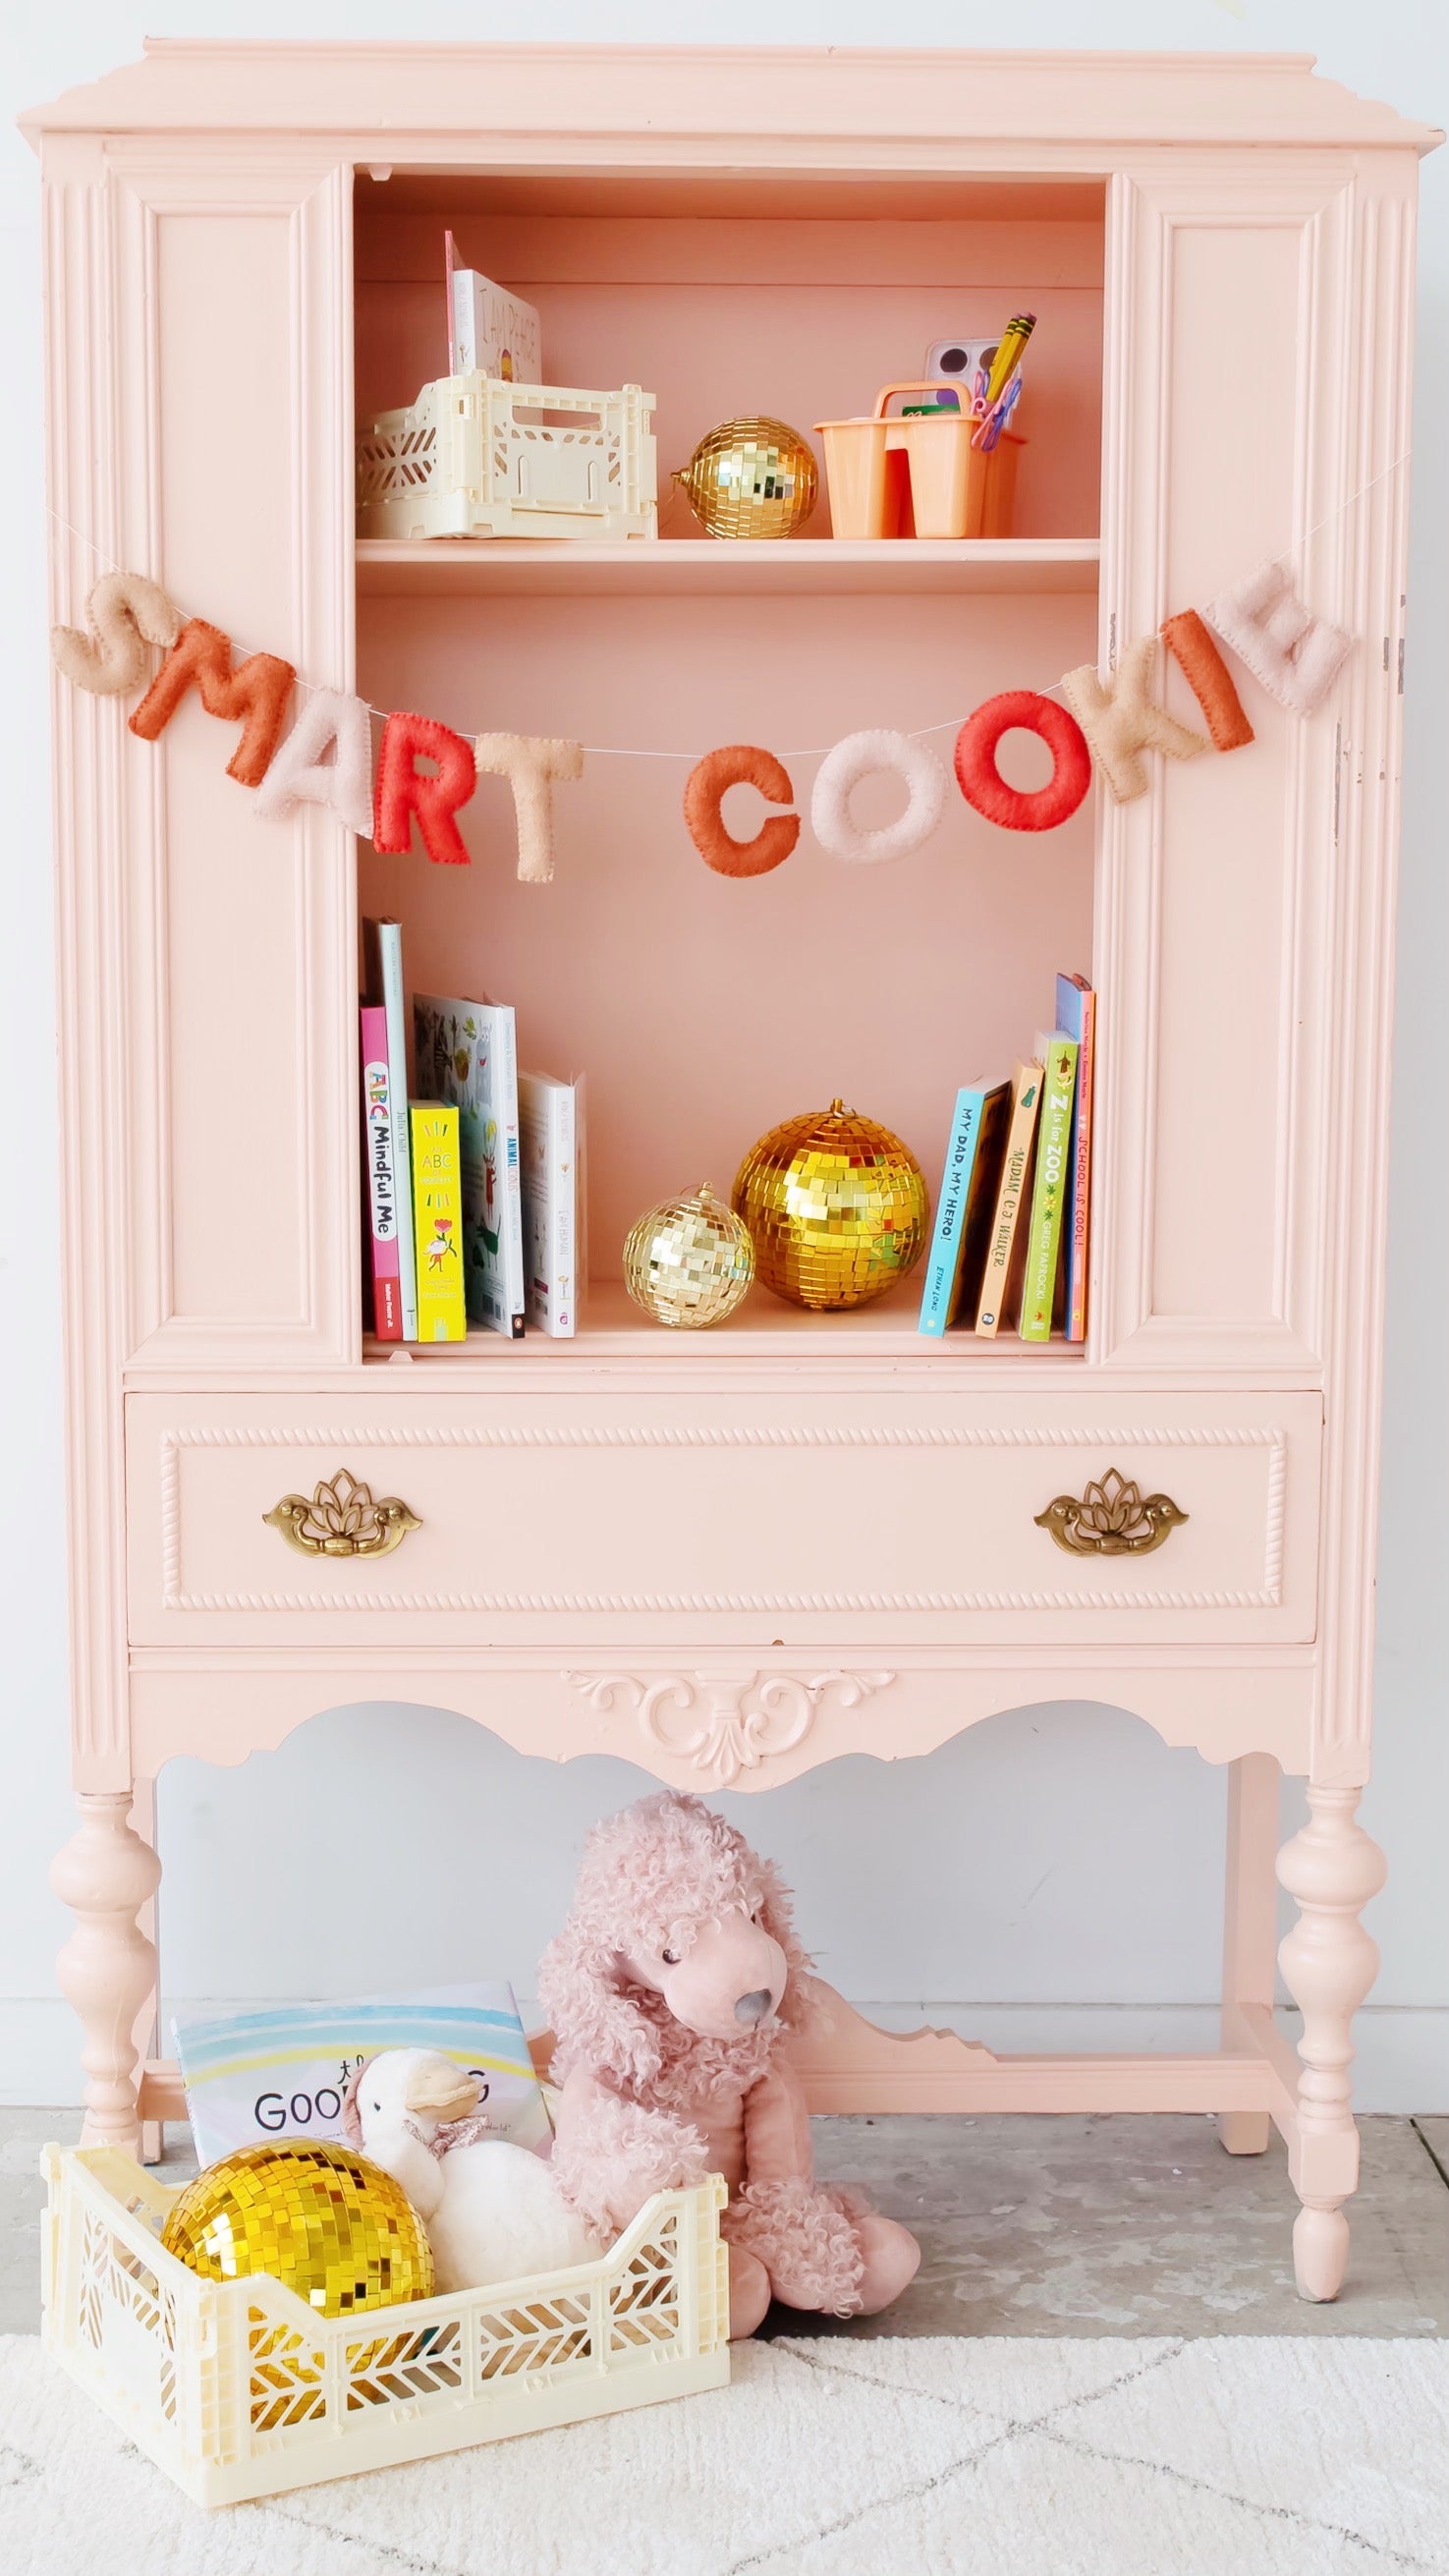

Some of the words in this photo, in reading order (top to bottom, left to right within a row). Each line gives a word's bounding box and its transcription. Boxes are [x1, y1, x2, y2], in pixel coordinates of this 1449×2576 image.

[50, 570, 585, 883] SMART
[683, 556, 1358, 878] COOKIE
[367, 1071, 390, 1120] ABC
[1049, 1092, 1069, 1111] Z
[961, 1107, 974, 1132] MY
[1051, 1126, 1063, 1142] for
[1053, 1113, 1064, 1123] is
[372, 1125, 394, 1204] Mindful
[422, 1153, 452, 1169] ABC
[951, 1135, 969, 1167] DAD,
[1044, 1145, 1062, 1183] ZOO
[1077, 1136, 1087, 1188] SCHOOL
[949, 1172, 962, 1196] MY
[1003, 1148, 1025, 1196] MADAM
[1076, 1193, 1086, 1204] IS
[377, 1208, 392, 1234] Me
[940, 1198, 958, 1241] HERO!
[1040, 1221, 1052, 1249] GREG
[1075, 1210, 1086, 1246] COOL!
[935, 1266, 944, 1292] ETHAN
[1036, 1253, 1049, 1300] PAPROCKI
[254, 2085, 349, 2131] GOO
